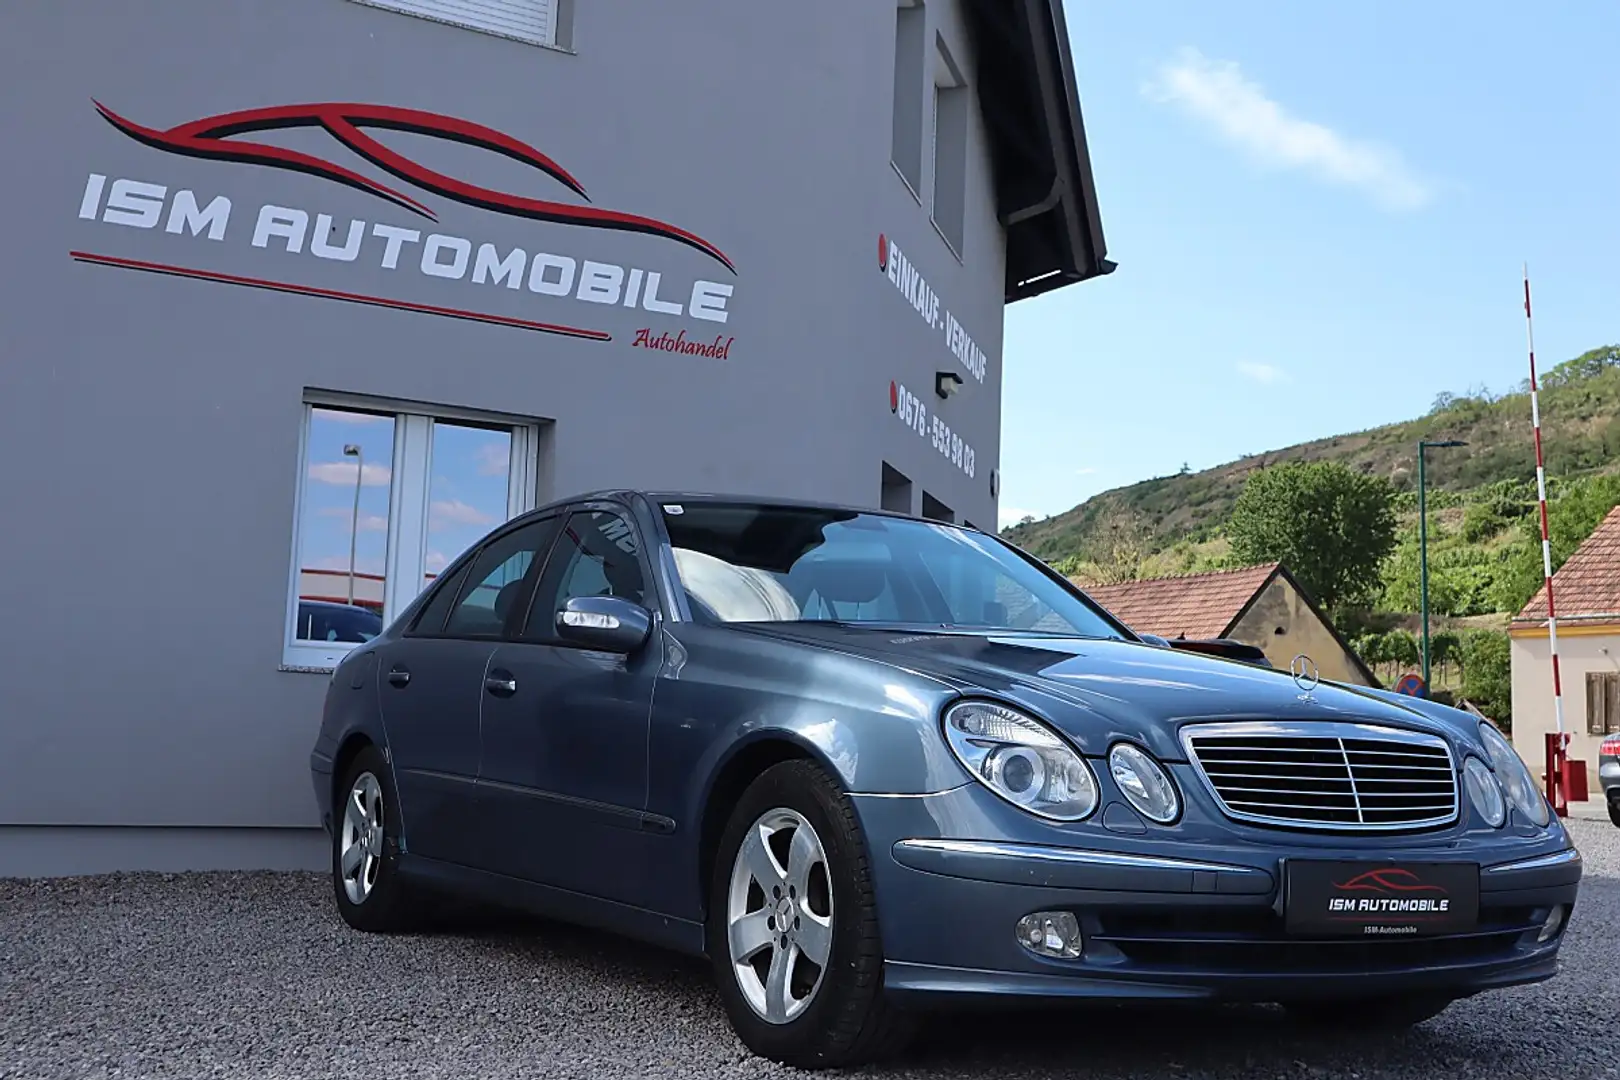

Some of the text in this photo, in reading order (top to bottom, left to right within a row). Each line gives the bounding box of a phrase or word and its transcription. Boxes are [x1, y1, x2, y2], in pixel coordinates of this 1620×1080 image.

[78, 173, 735, 324] ISM AUTOMOBILE
[632, 328, 735, 360] Autohandel
[888, 240, 940, 329] EINKAUF
[946, 310, 987, 384] VERKAUF
[899, 384, 926, 437] 0676
[932, 414, 951, 459] 553
[964, 444, 975, 479] 03
[1328, 898, 1449, 912] ISM AUTOMOBILE
